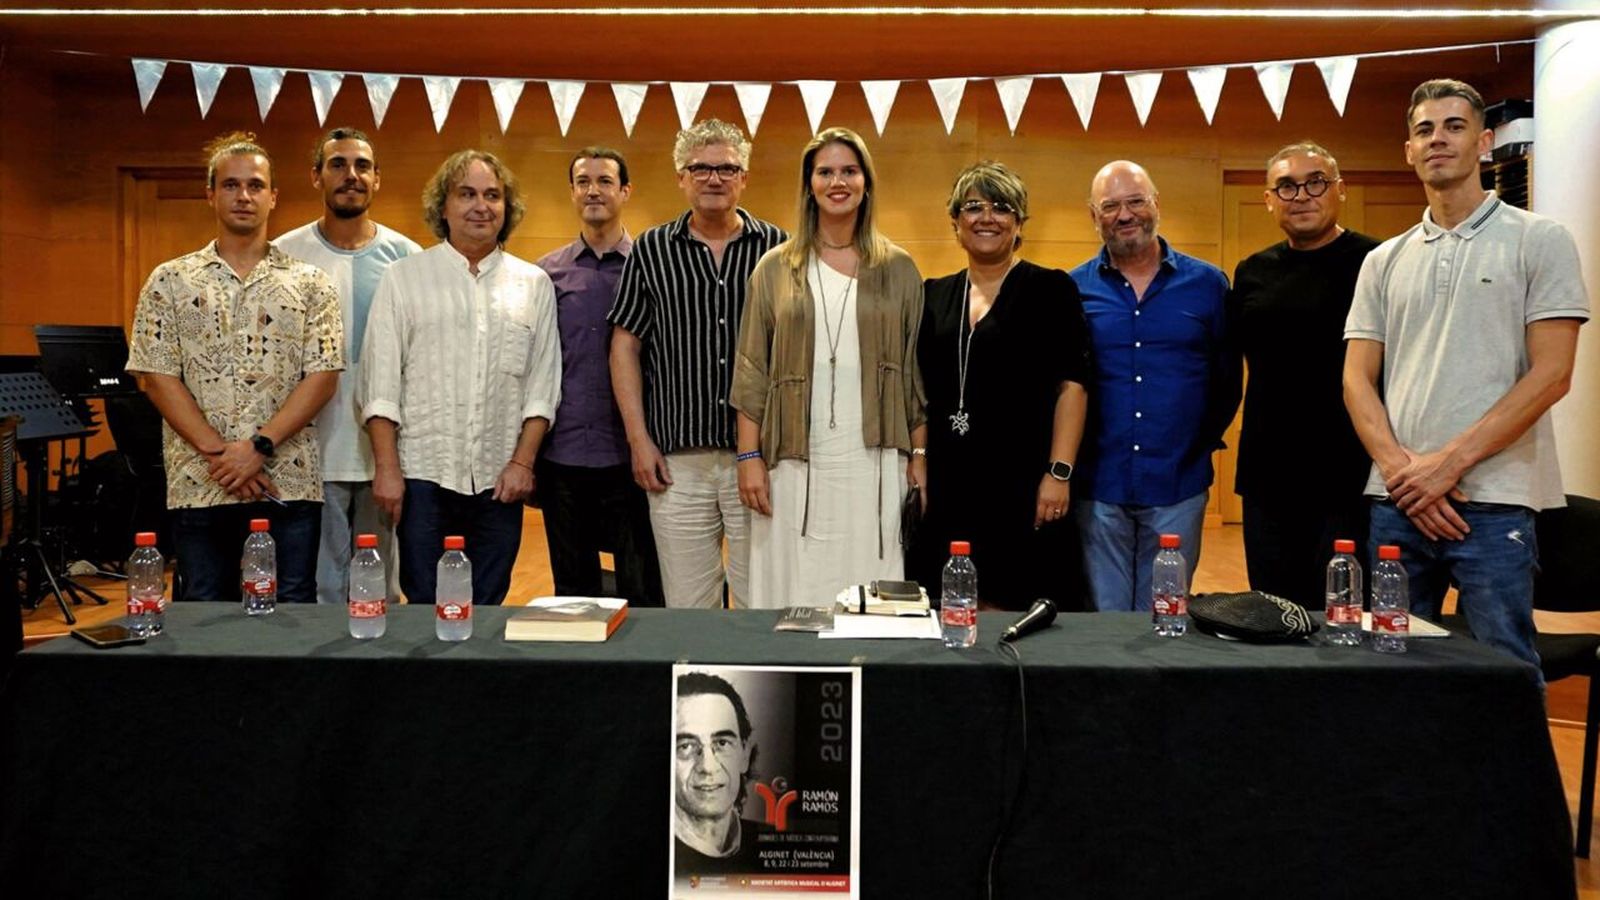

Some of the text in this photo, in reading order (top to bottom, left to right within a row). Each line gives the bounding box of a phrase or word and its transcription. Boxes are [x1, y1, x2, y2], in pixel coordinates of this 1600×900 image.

[821, 681, 842, 762] 2023
[802, 789, 839, 801] RAMÓN
[802, 802, 839, 812] RAMOS
[759, 849, 835, 861] ALGINET (VALÈNCIA)
[779, 860, 787, 868] 22
